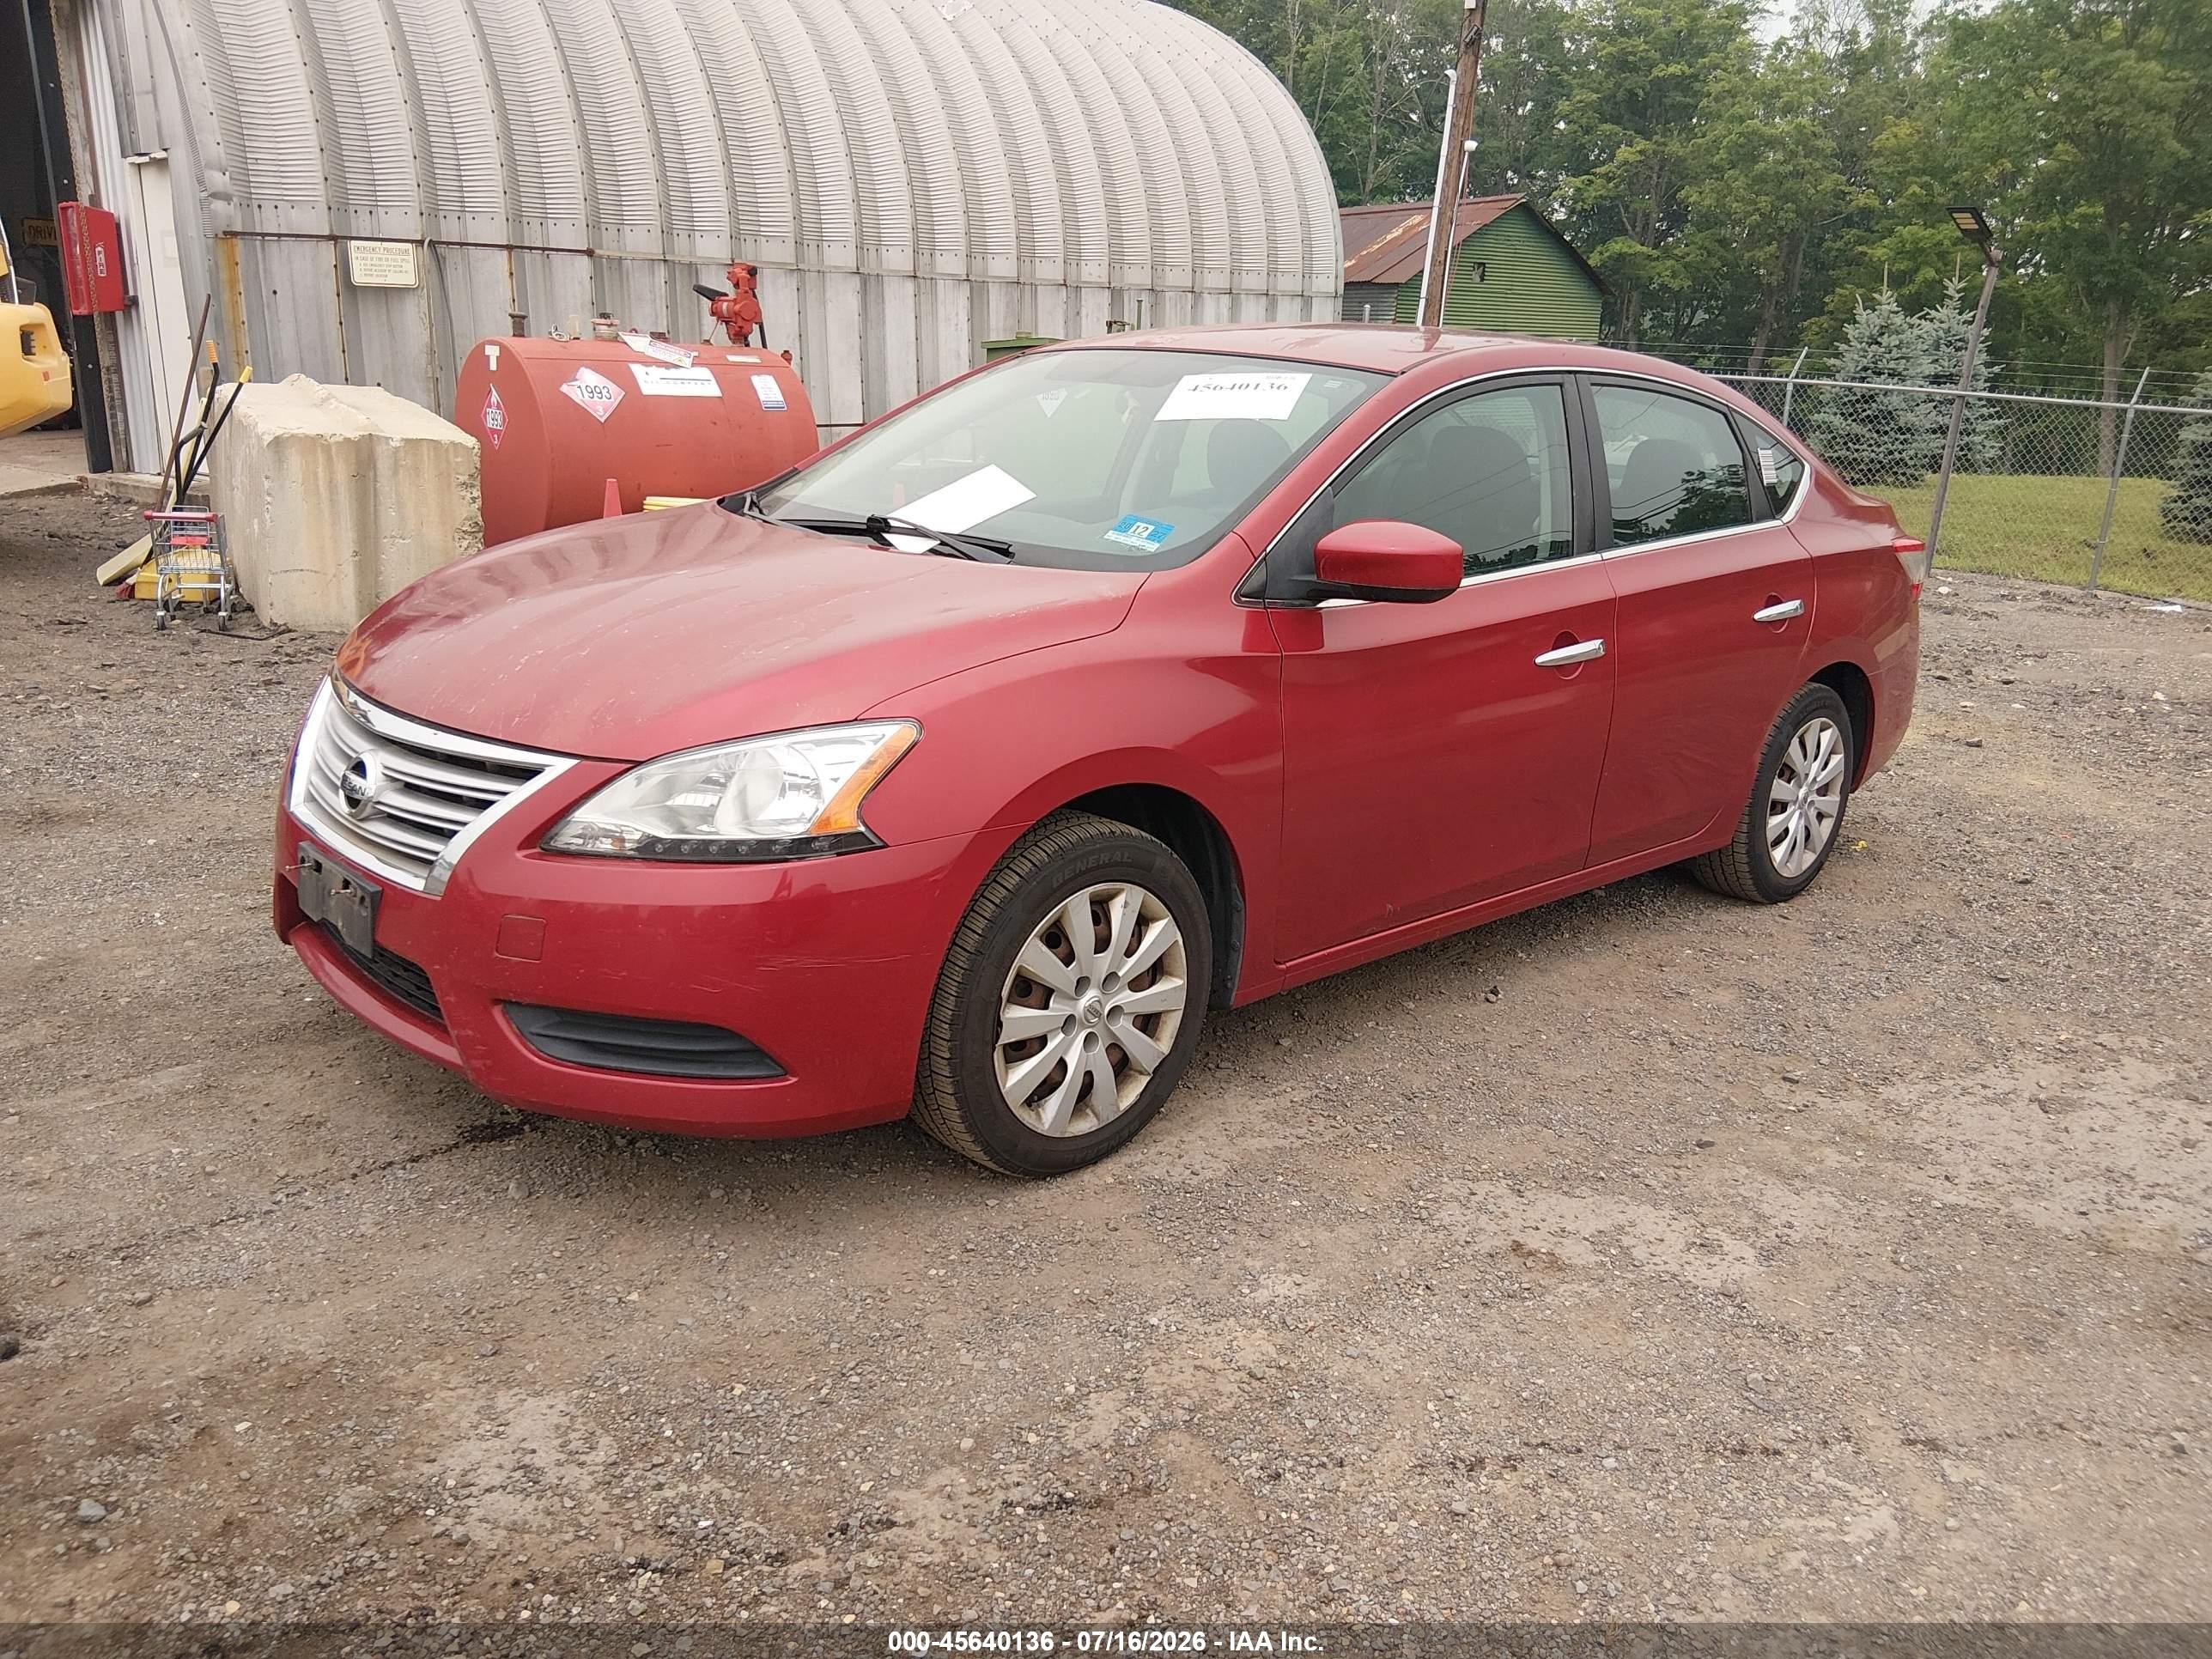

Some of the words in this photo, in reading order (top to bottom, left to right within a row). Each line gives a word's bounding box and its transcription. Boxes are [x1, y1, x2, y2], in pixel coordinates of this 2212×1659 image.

[354, 245, 381, 254] EMERGENCY
[577, 384, 612, 400] 1993
[487, 410, 502, 428] 1993
[1131, 525, 1149, 537] 12
[1052, 851, 1133, 888] GENERAL
